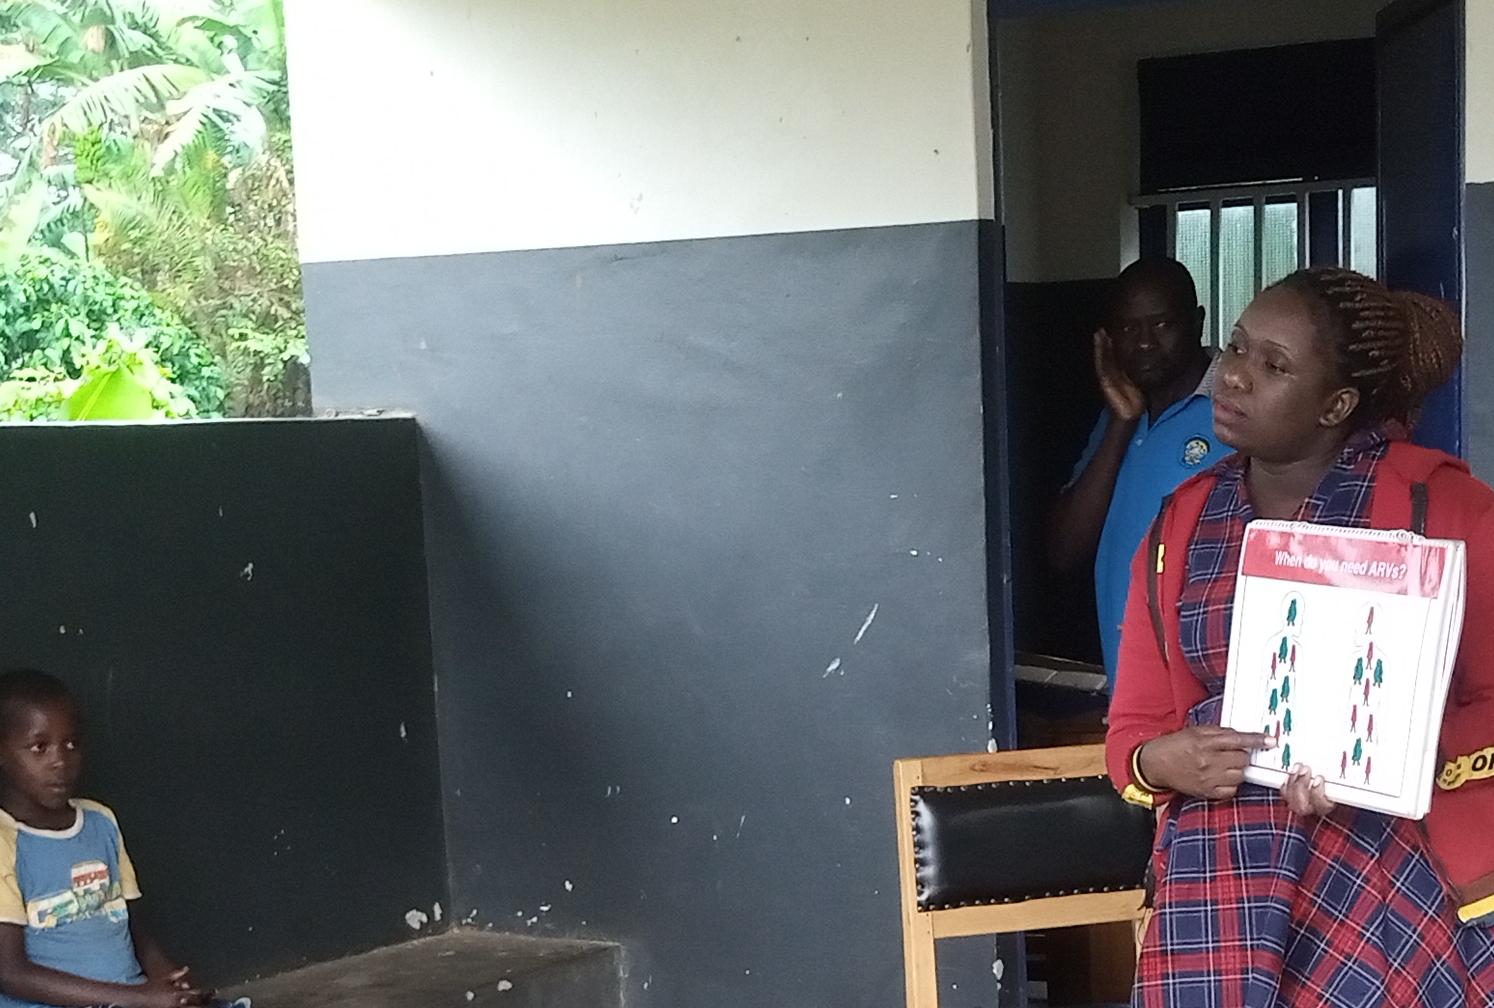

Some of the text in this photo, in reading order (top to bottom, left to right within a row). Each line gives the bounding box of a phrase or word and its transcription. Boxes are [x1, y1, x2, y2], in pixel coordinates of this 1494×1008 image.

[1274, 550, 1407, 580] When do you need ARVs?
